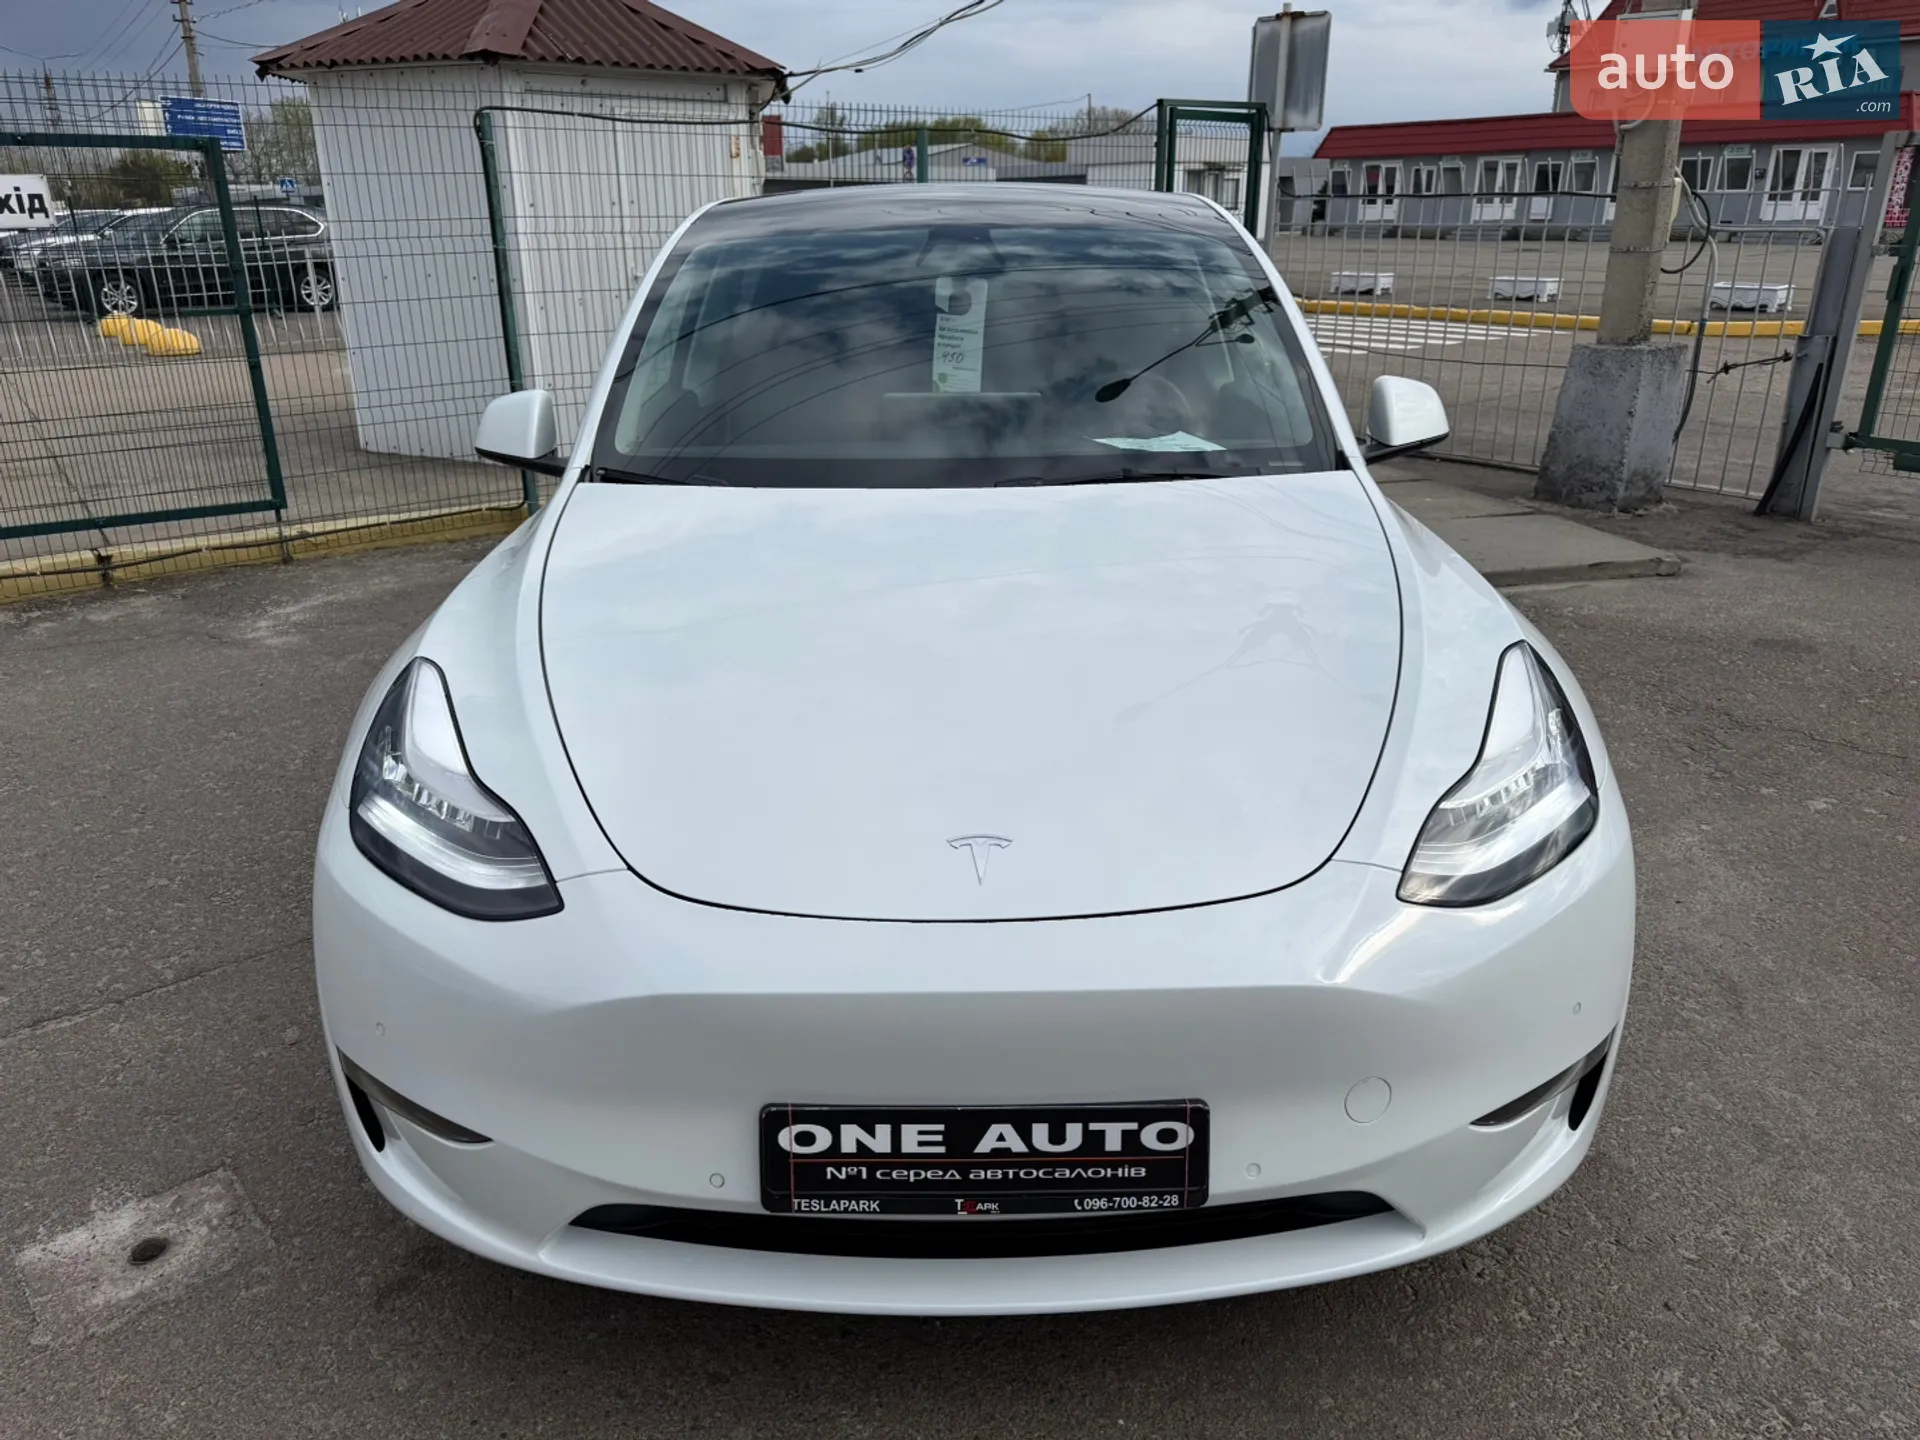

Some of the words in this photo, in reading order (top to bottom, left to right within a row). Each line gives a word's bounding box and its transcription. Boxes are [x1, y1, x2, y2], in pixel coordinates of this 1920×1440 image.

[777, 1123, 946, 1154] ONE
[973, 1121, 1195, 1153] AUTO
[875, 1169, 963, 1183] серед
[968, 1164, 1147, 1180] автосалонів
[792, 1199, 881, 1212] TESLAPARK
[1083, 1195, 1180, 1211] 096-700-82-28
